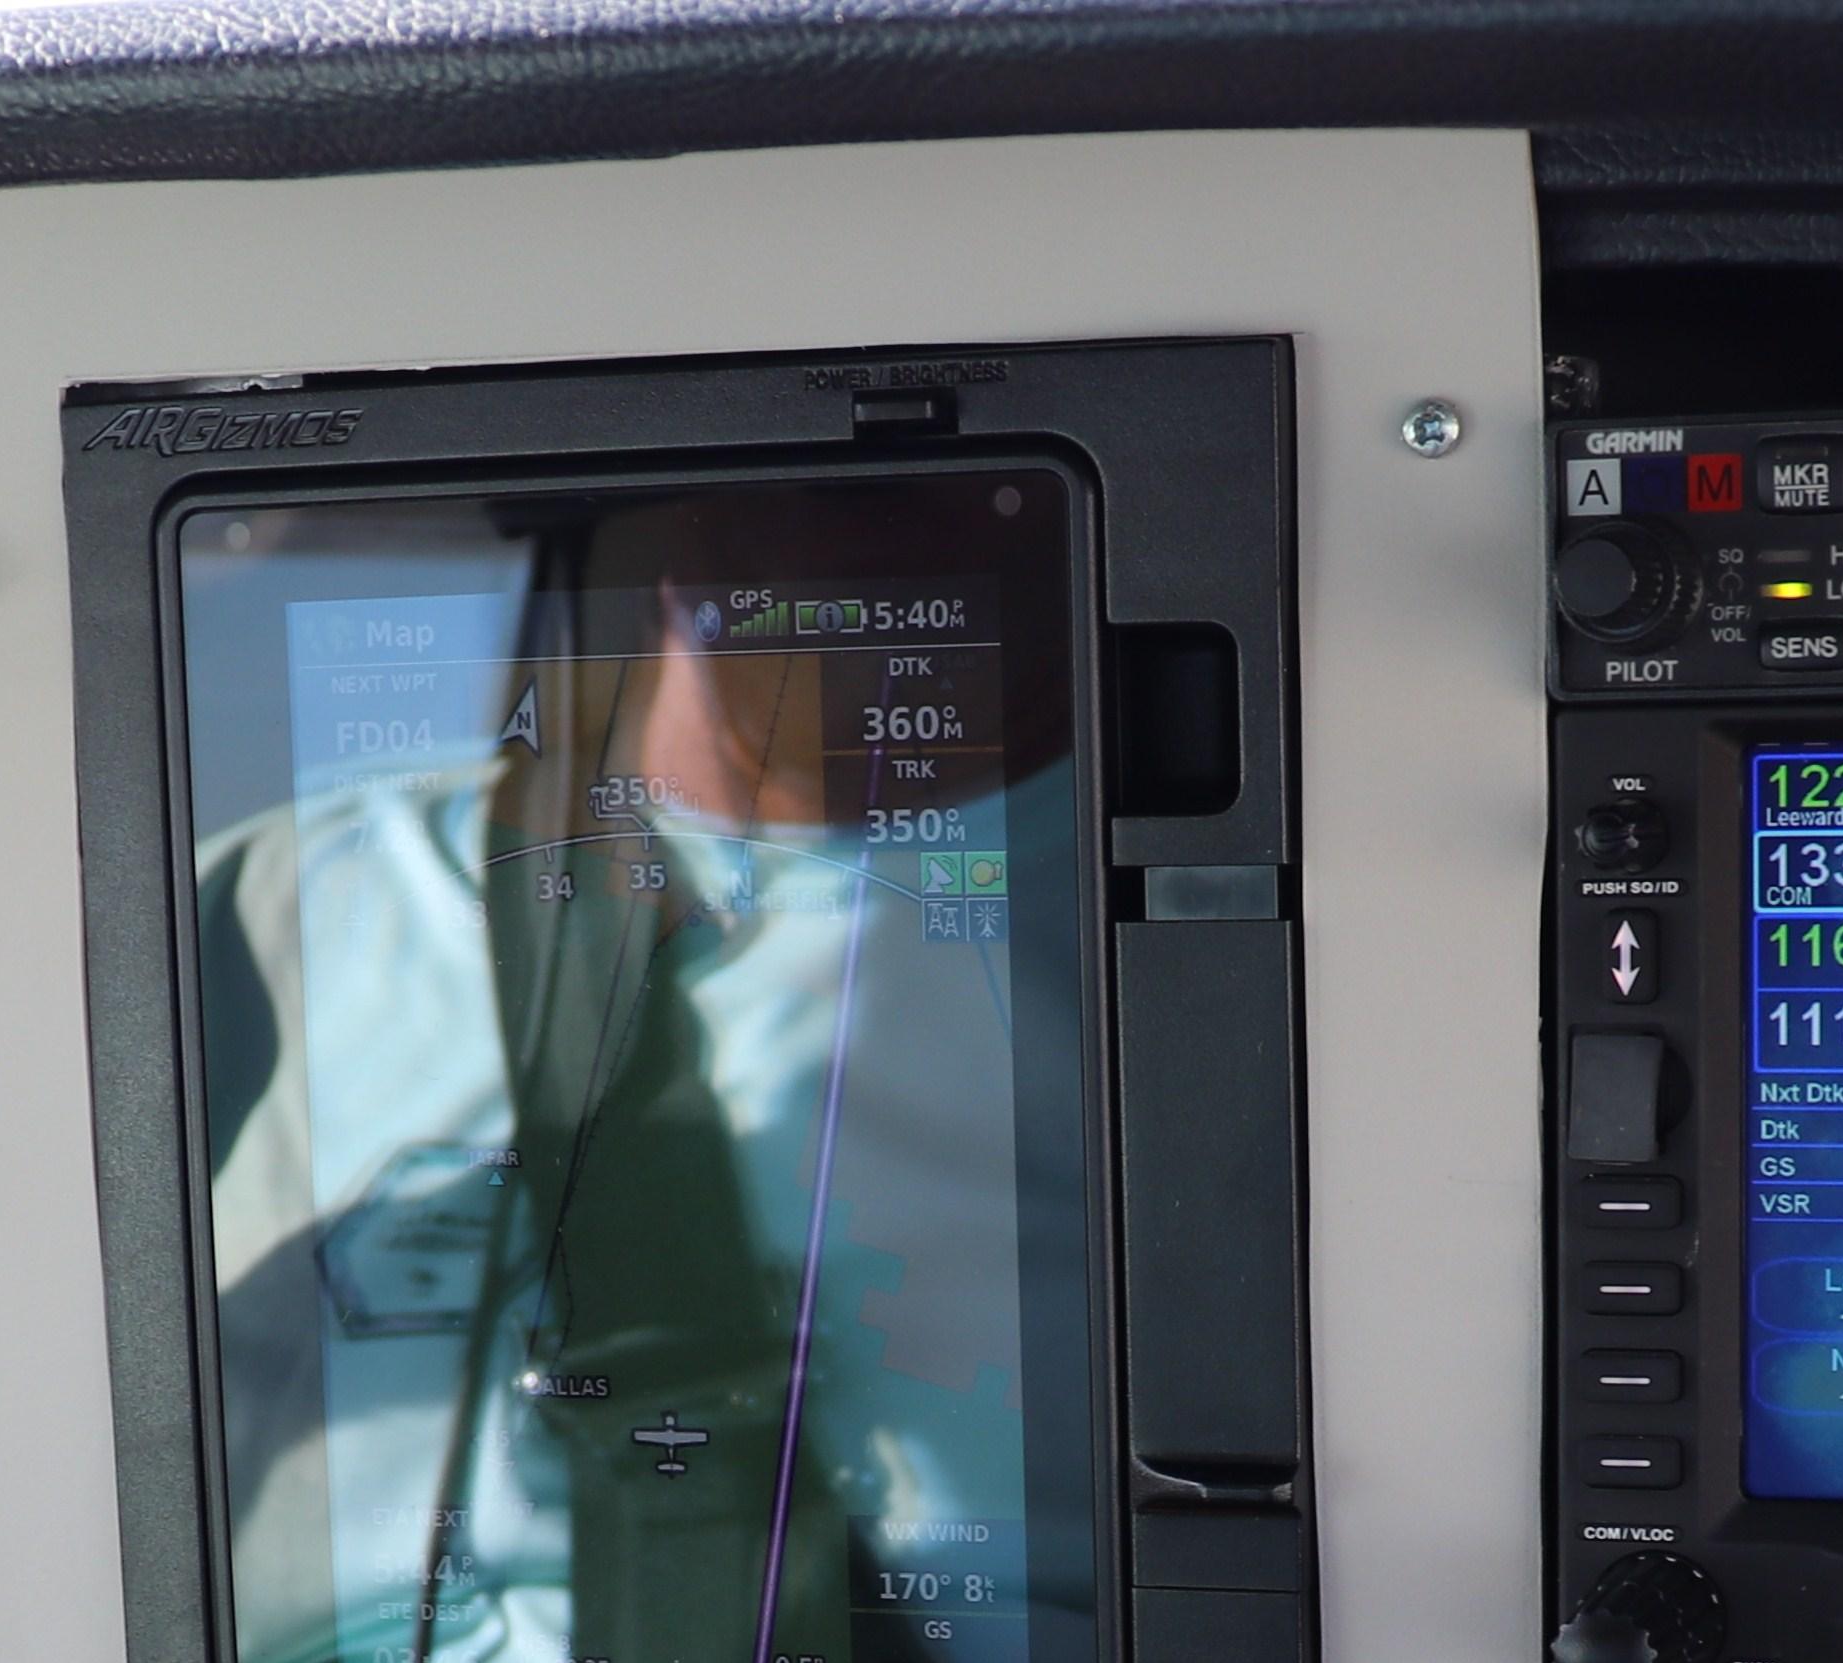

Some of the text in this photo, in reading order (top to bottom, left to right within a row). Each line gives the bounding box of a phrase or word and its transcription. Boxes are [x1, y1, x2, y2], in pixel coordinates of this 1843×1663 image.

[1586, 430, 1682, 454] GARMIN
[1773, 463, 1828, 487] MKR
[1775, 488, 1829, 508] MUTE
[730, 590, 772, 609] GPS
[366, 619, 434, 651] Map
[1770, 637, 1838, 659] SENS
[889, 658, 931, 676] DTK
[1606, 661, 1677, 681] PILOT
[336, 719, 433, 754] FD04
[893, 760, 936, 779] TRK
